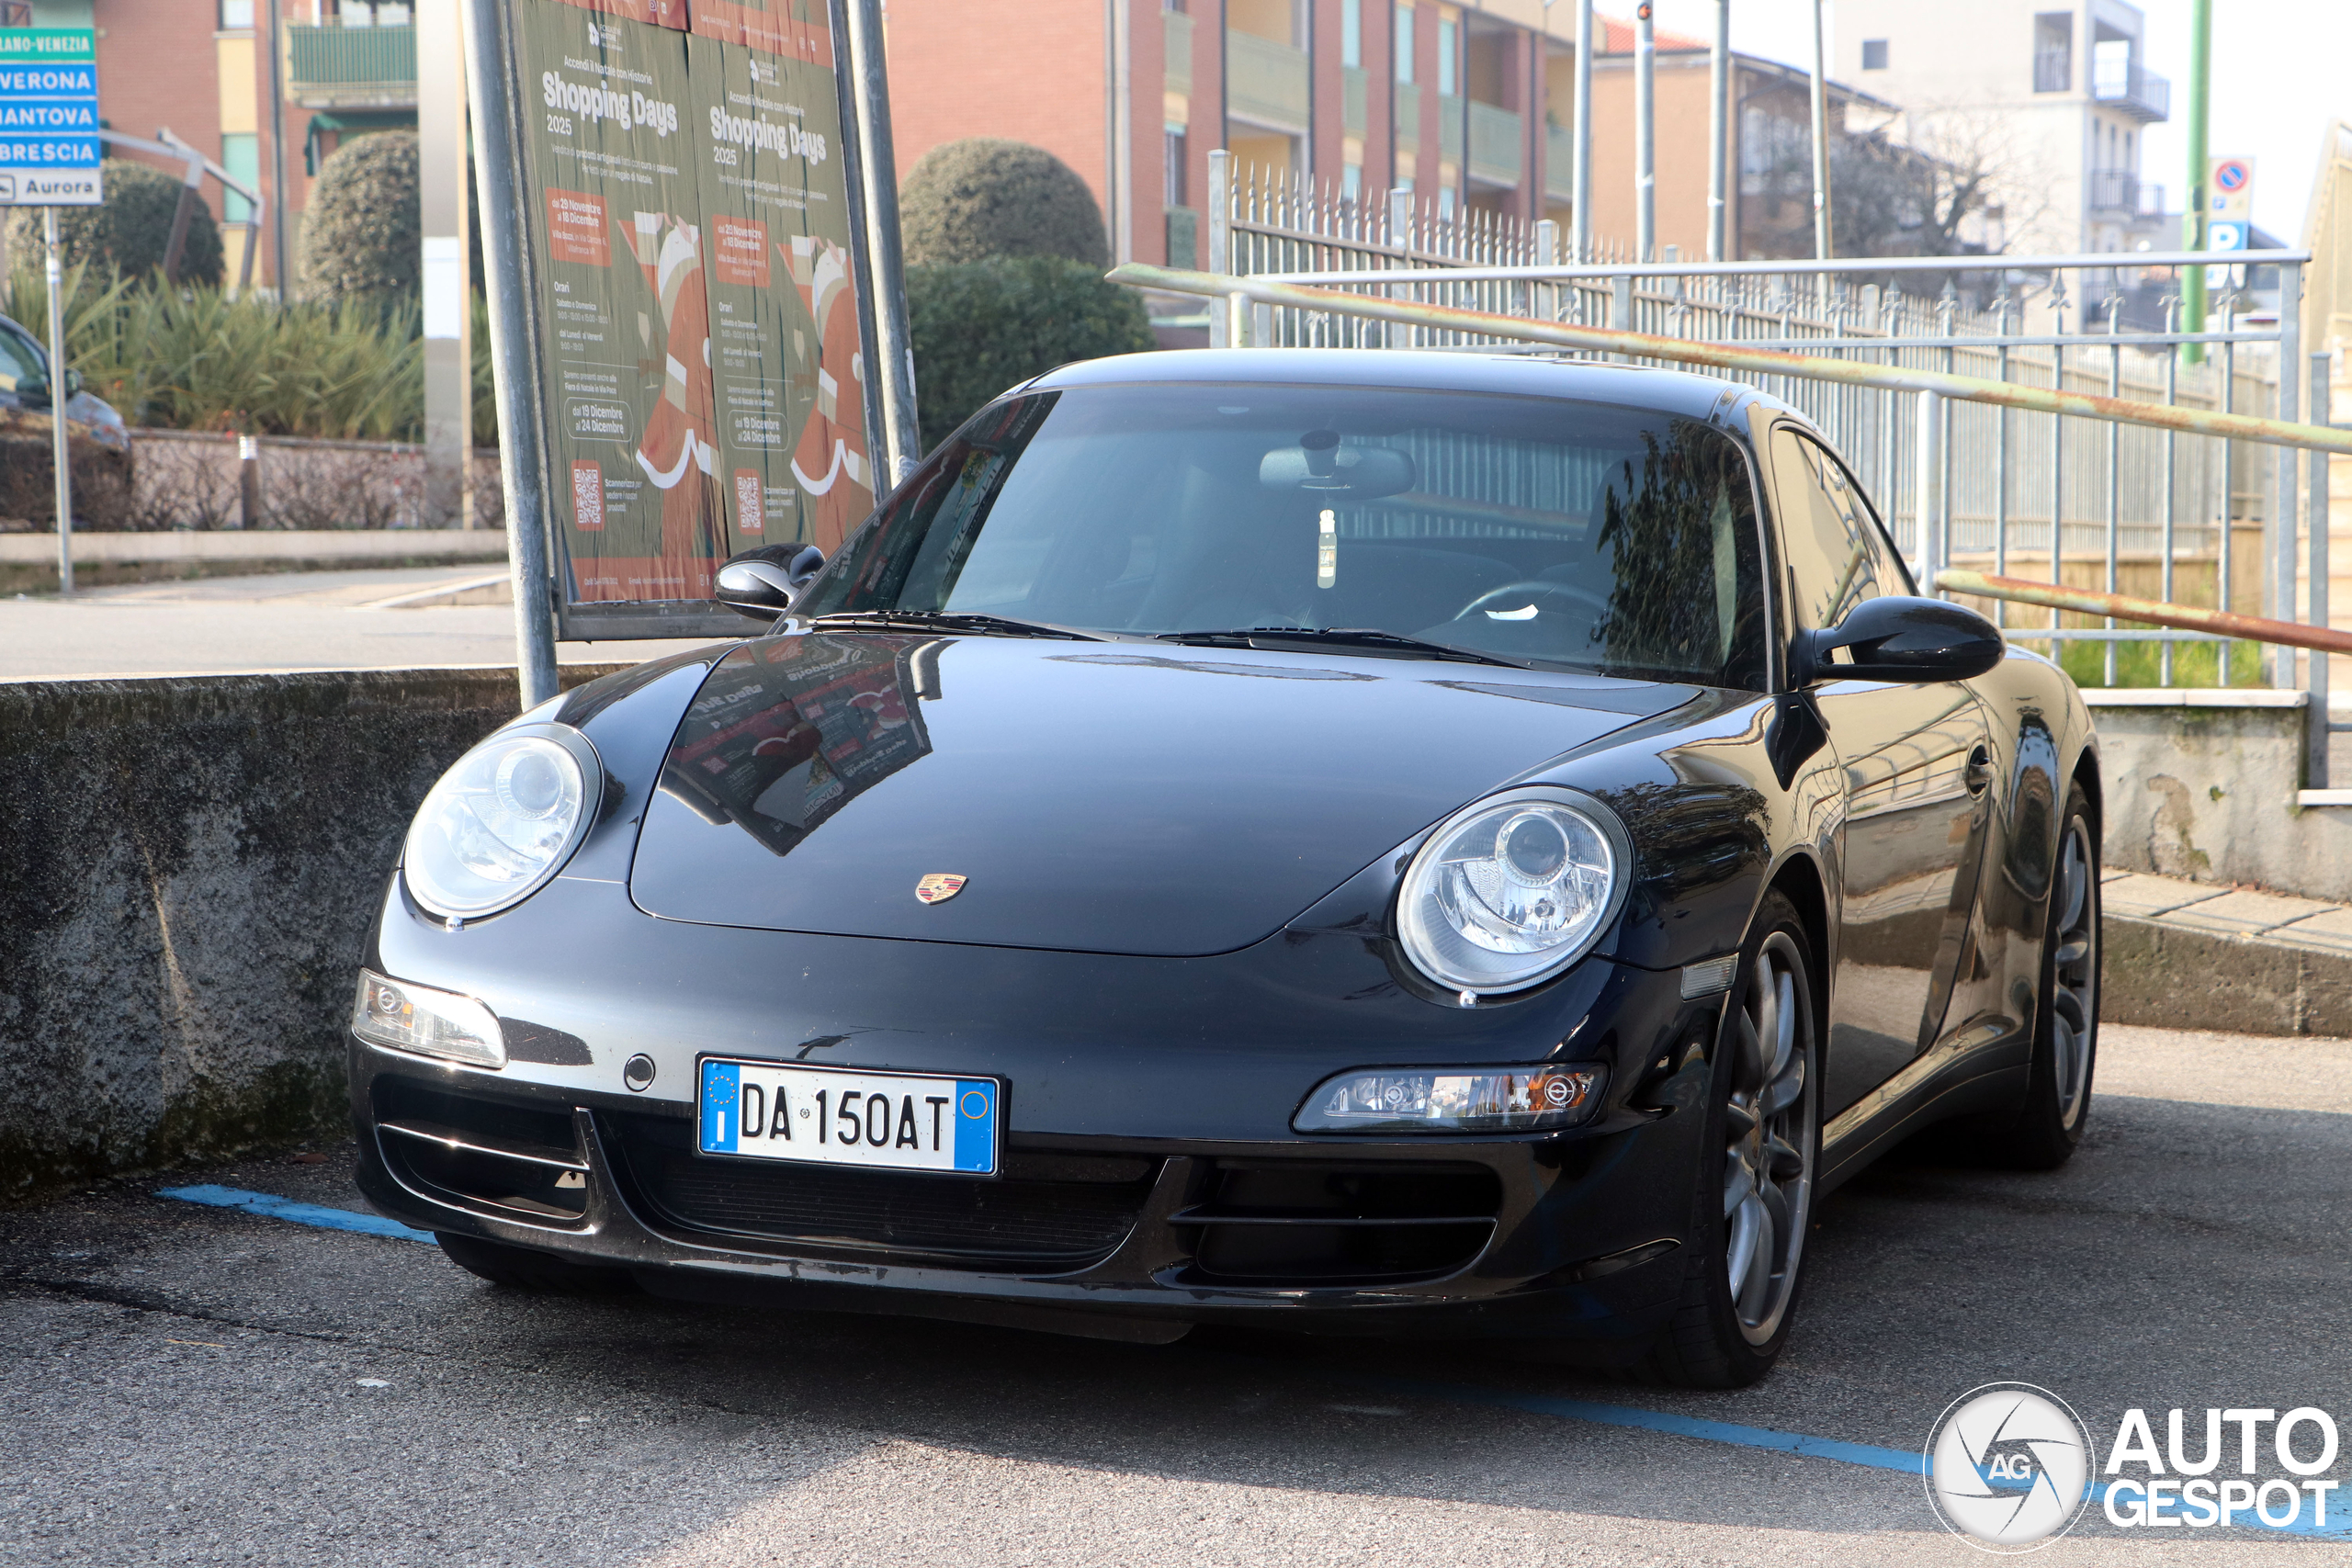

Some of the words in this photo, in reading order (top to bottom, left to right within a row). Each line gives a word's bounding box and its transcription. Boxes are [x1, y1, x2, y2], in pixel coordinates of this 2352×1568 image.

[564, 55, 588, 72] Accendi
[590, 59, 594, 72] il
[595, 62, 616, 77] Natale
[617, 70, 627, 79] con
[628, 70, 652, 85] Historie
[0, 72, 91, 90] VERONA
[542, 71, 631, 130] Shopping
[632, 90, 678, 138] Days
[729, 90, 752, 107] Accendi
[755, 97, 774, 110] Natale
[774, 102, 785, 112] con
[785, 103, 805, 118] Historie
[547, 114, 571, 136] 2025
[710, 105, 788, 160] Shopping
[789, 122, 827, 165] Days
[0, 143, 96, 162] BRESCIA
[551, 143, 570, 156] Vendita
[714, 146, 737, 165] 2025
[26, 179, 94, 195] Aurora
[551, 198, 560, 209] dal
[560, 197, 568, 209] 29
[570, 199, 601, 215] Novembre
[558, 212, 562, 221] al
[562, 211, 570, 222] 18
[571, 212, 599, 228] Dicembre
[733, 225, 763, 239] Novembre
[734, 237, 761, 251] Dicembre
[554, 281, 570, 292] Orari
[557, 298, 571, 307] Sabato
[575, 300, 596, 310] Domenica
[718, 301, 733, 312] Orari
[738, 320, 757, 329] Domenica
[564, 371, 579, 379] Saremo
[597, 373, 608, 382] anche
[564, 382, 575, 391] Fiera
[576, 382, 581, 391] di
[581, 384, 594, 392] Natale
[594, 384, 599, 393] in
[606, 386, 617, 395] Pace
[728, 396, 737, 404] Fiera
[572, 405, 581, 416] dal
[582, 404, 590, 417] 19
[590, 404, 623, 420] Dicembre
[575, 421, 581, 431] al
[581, 419, 591, 432] 24
[592, 419, 624, 434] Dicembre
[743, 417, 750, 428] 19
[751, 416, 779, 430] Dicembre
[738, 432, 742, 441] al
[743, 431, 752, 442] 24
[752, 430, 781, 444] Dicembre
[605, 478, 634, 487] Scannerizza
[741, 1082, 791, 1141] DA
[816, 1089, 950, 1151] 150AT
